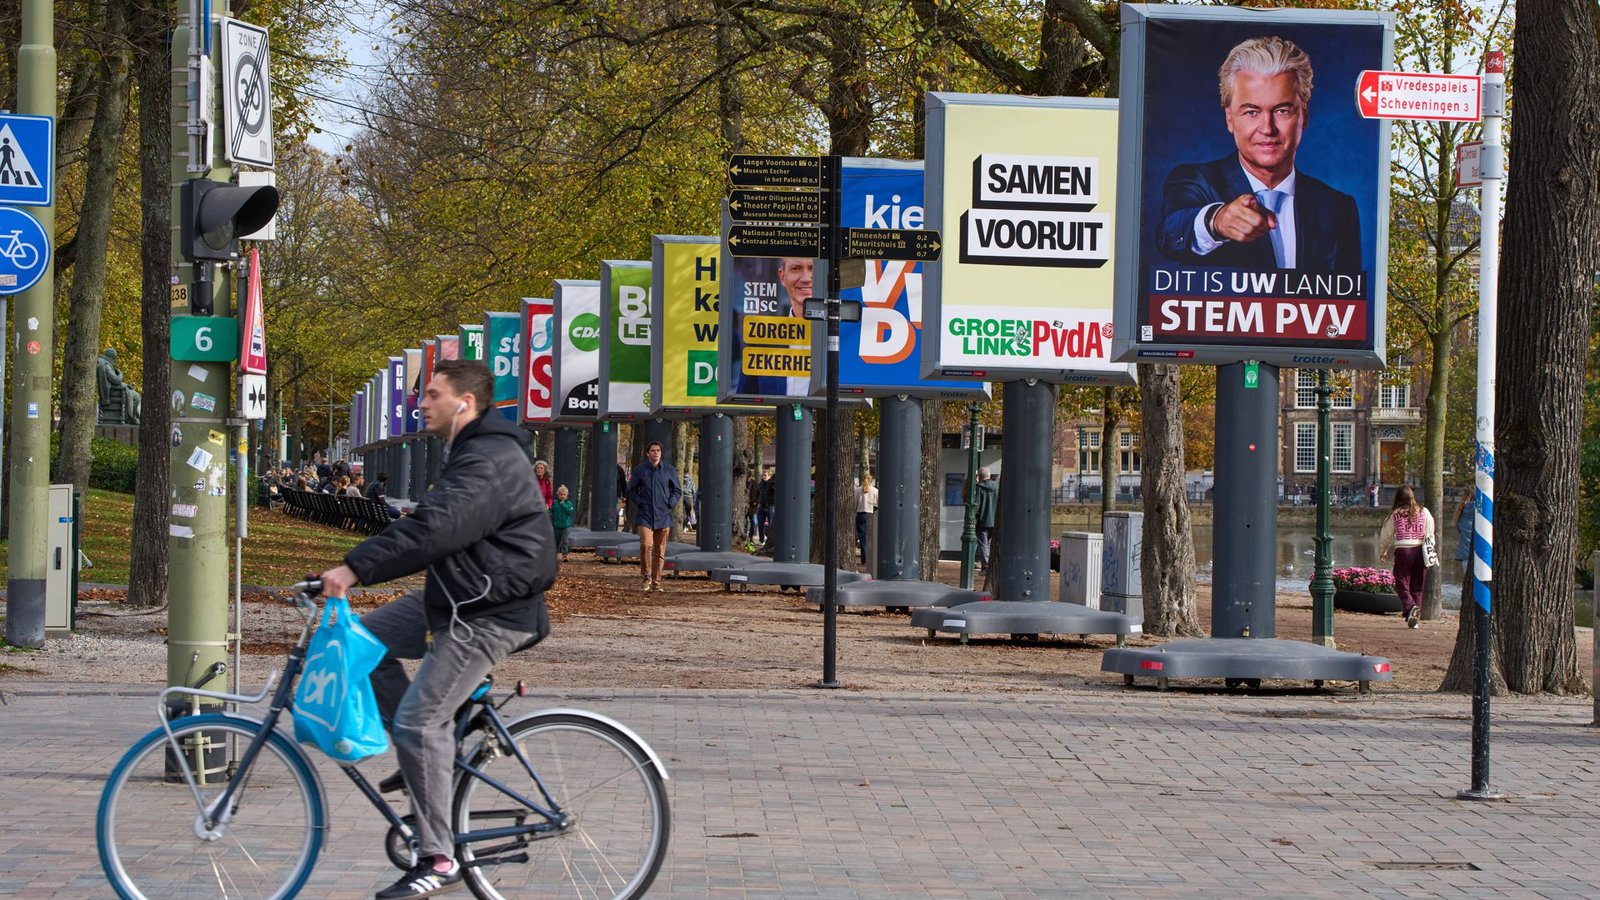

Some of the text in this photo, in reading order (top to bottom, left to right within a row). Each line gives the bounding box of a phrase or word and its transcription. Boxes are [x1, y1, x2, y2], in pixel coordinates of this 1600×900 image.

[238, 33, 258, 49] ZONE
[240, 78, 261, 111] 30
[1396, 79, 1468, 94] Vredespaleis
[1380, 98, 1469, 115] Scheveningen 3
[743, 159, 764, 167] Lange
[765, 159, 797, 167] Voorhout
[988, 163, 1091, 196] SAMEN
[773, 203, 795, 211] Pepijn
[864, 194, 924, 229] kie
[742, 229, 776, 237] Nationaal
[777, 230, 799, 238] Toneel
[852, 231, 890, 239] Binnenhof
[975, 218, 1103, 251] VOORUIT
[851, 240, 897, 248] Mauritshuis
[744, 282, 777, 297] STEM
[1155, 269, 1362, 296] DIT IS UW LAND!
[619, 286, 651, 317] B
[1160, 299, 1264, 334] STEM
[1275, 303, 1356, 335] PVV
[195, 326, 213, 352] 6
[623, 324, 651, 339] LE
[748, 322, 806, 340] ZORGEN
[949, 317, 1104, 359] GROEN PvdA
[962, 337, 1031, 357] LINKS
[747, 353, 812, 372] ZEKERHE
